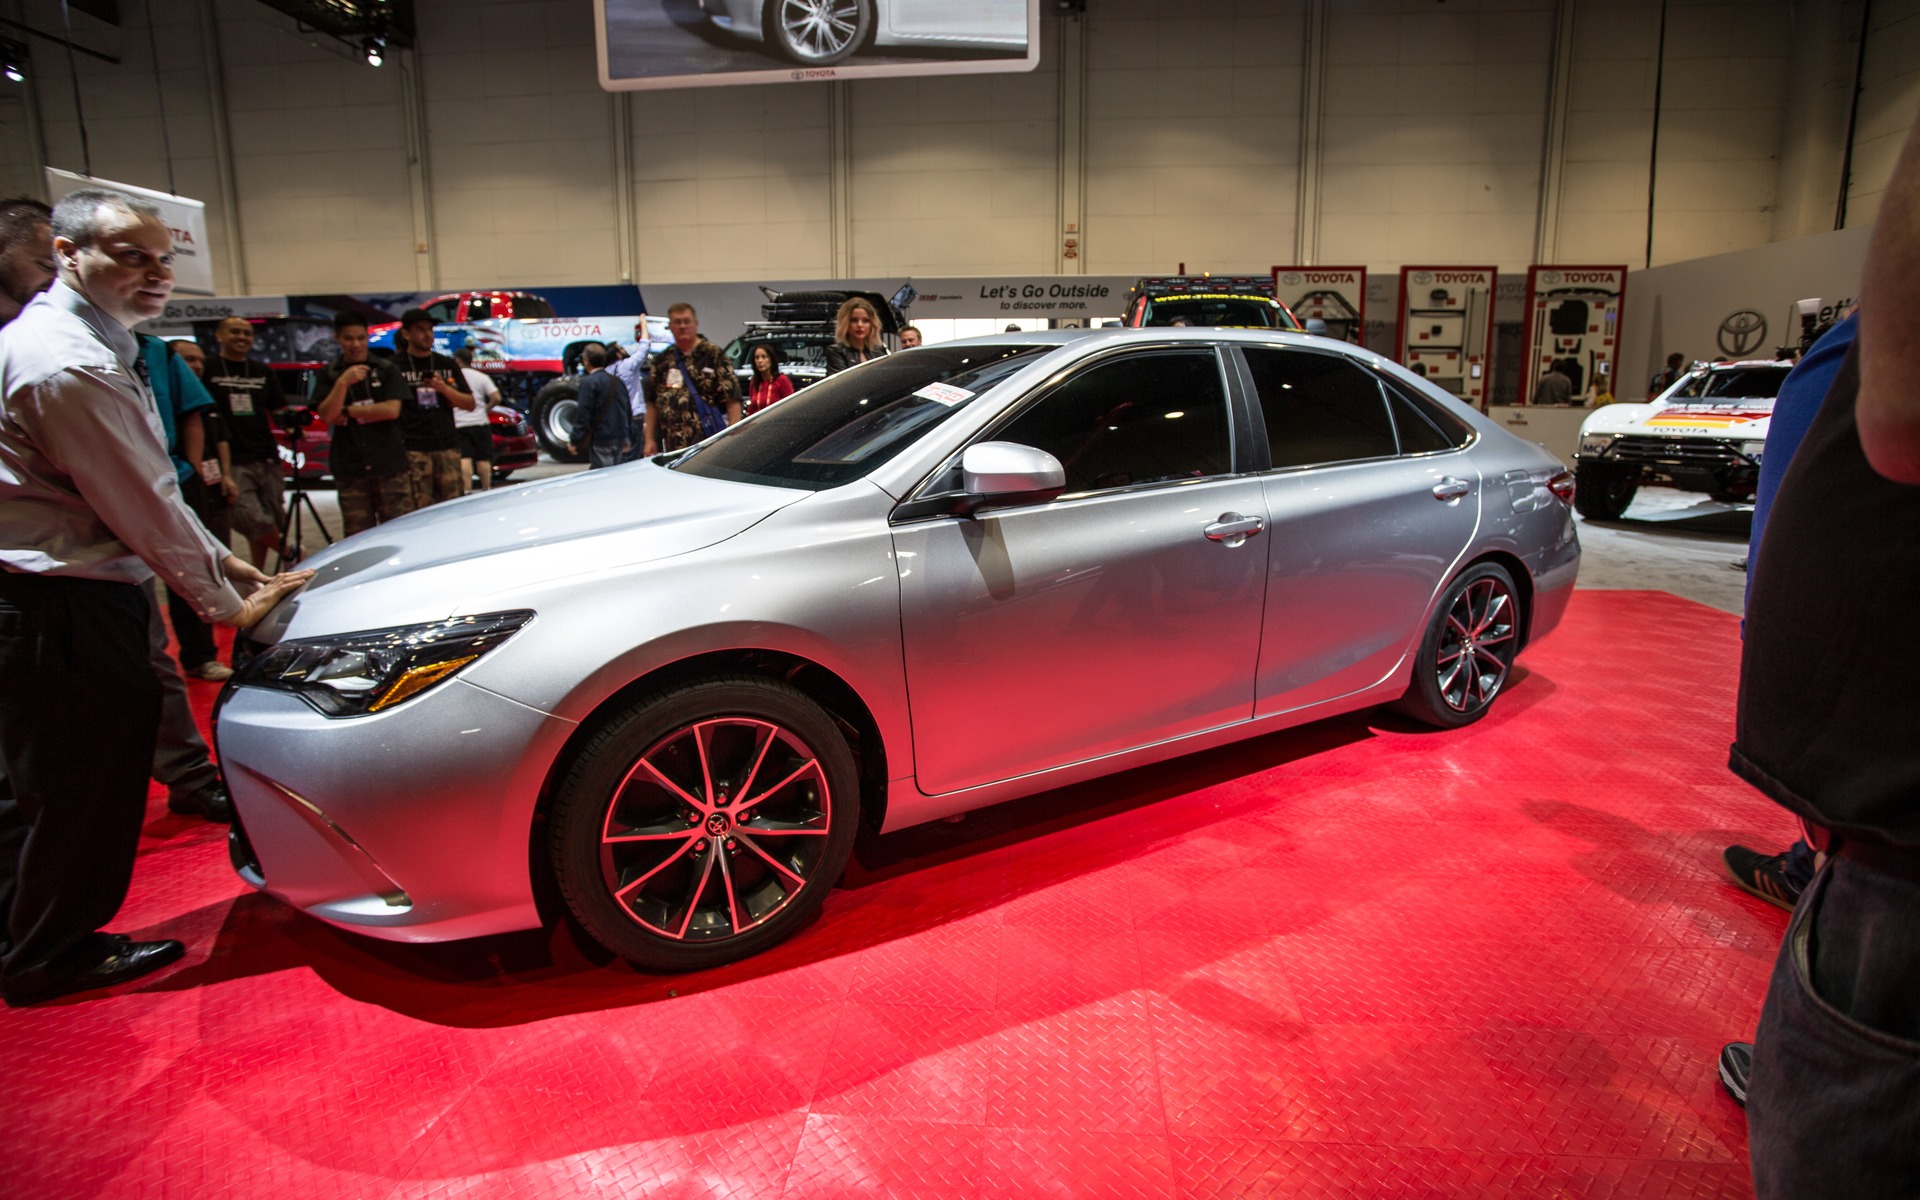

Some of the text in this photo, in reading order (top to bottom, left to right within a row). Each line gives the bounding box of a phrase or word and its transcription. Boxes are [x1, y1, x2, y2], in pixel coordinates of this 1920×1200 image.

[805, 69, 836, 78] TOYOTA
[1304, 273, 1355, 284] TOYOTA
[1434, 273, 1485, 284] TOYOTA
[1563, 272, 1615, 283] TOYOTA
[980, 283, 1109, 299] Let's Go Outside
[1000, 301, 1087, 310] to discover more.
[542, 325, 602, 337] TOYOTA
